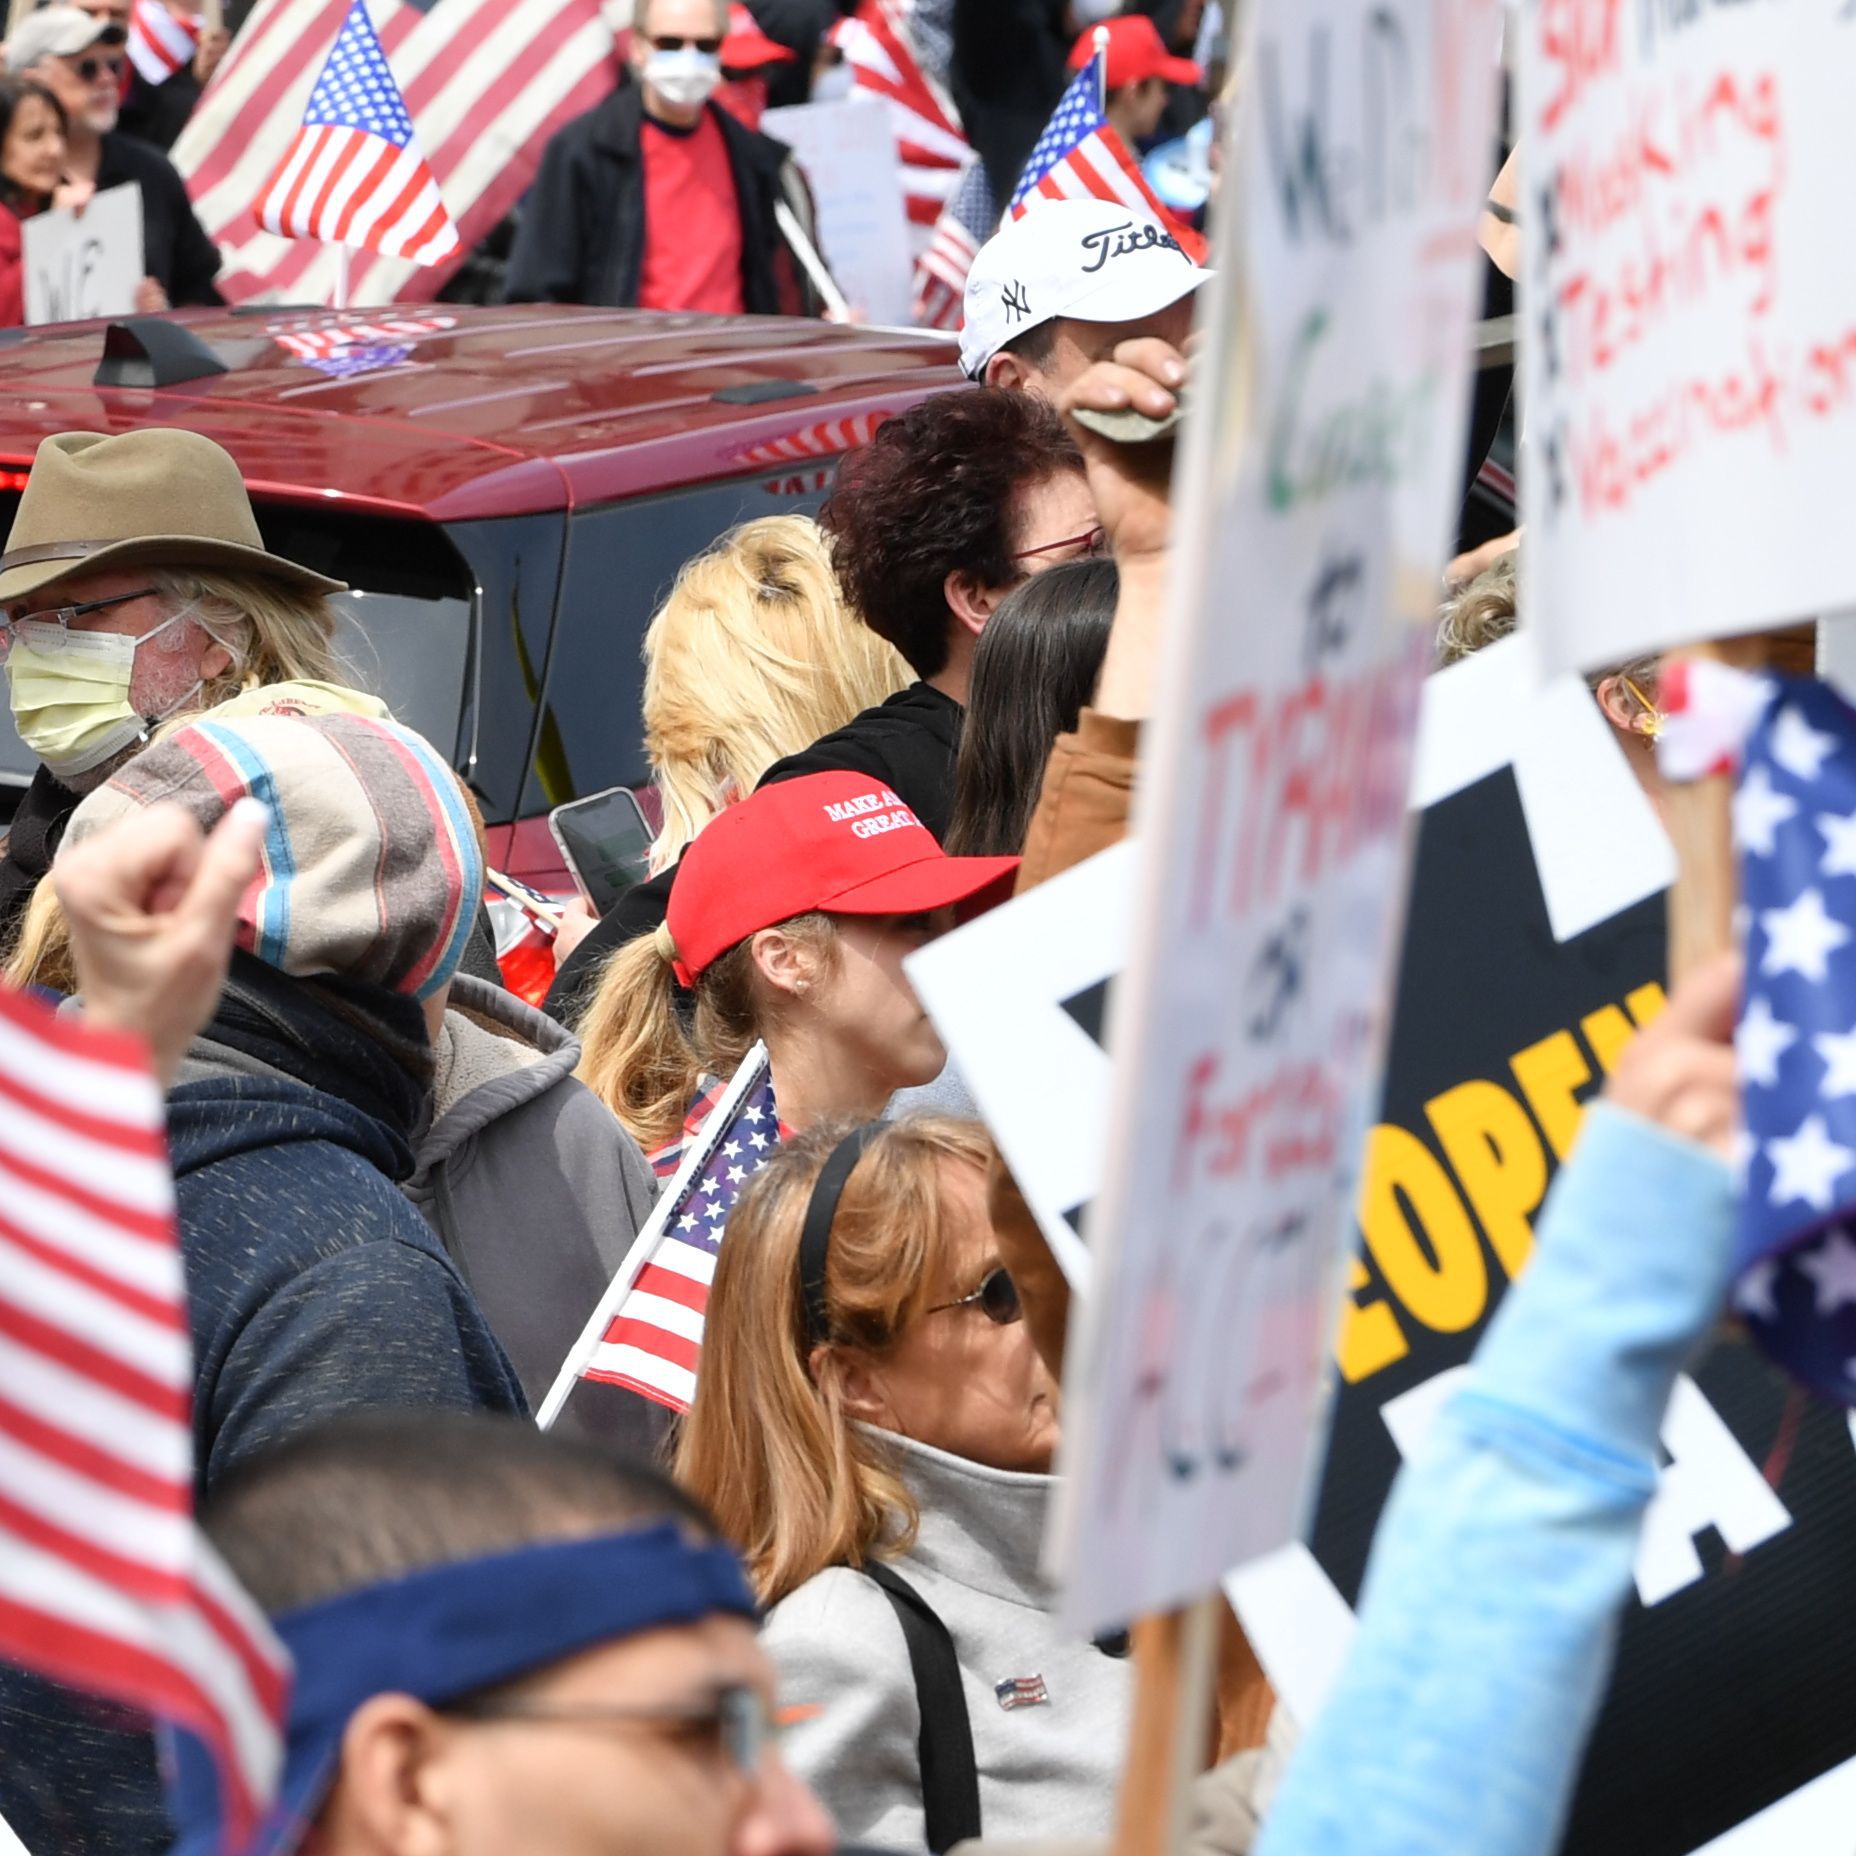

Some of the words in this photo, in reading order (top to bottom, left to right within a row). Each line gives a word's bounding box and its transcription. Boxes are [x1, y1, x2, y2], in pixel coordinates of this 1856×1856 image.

[1001, 278, 1032, 324] NY
[1556, 186, 1776, 389] Testing
[823, 793, 884, 822] MAKE
[850, 809, 915, 839] GREAT
